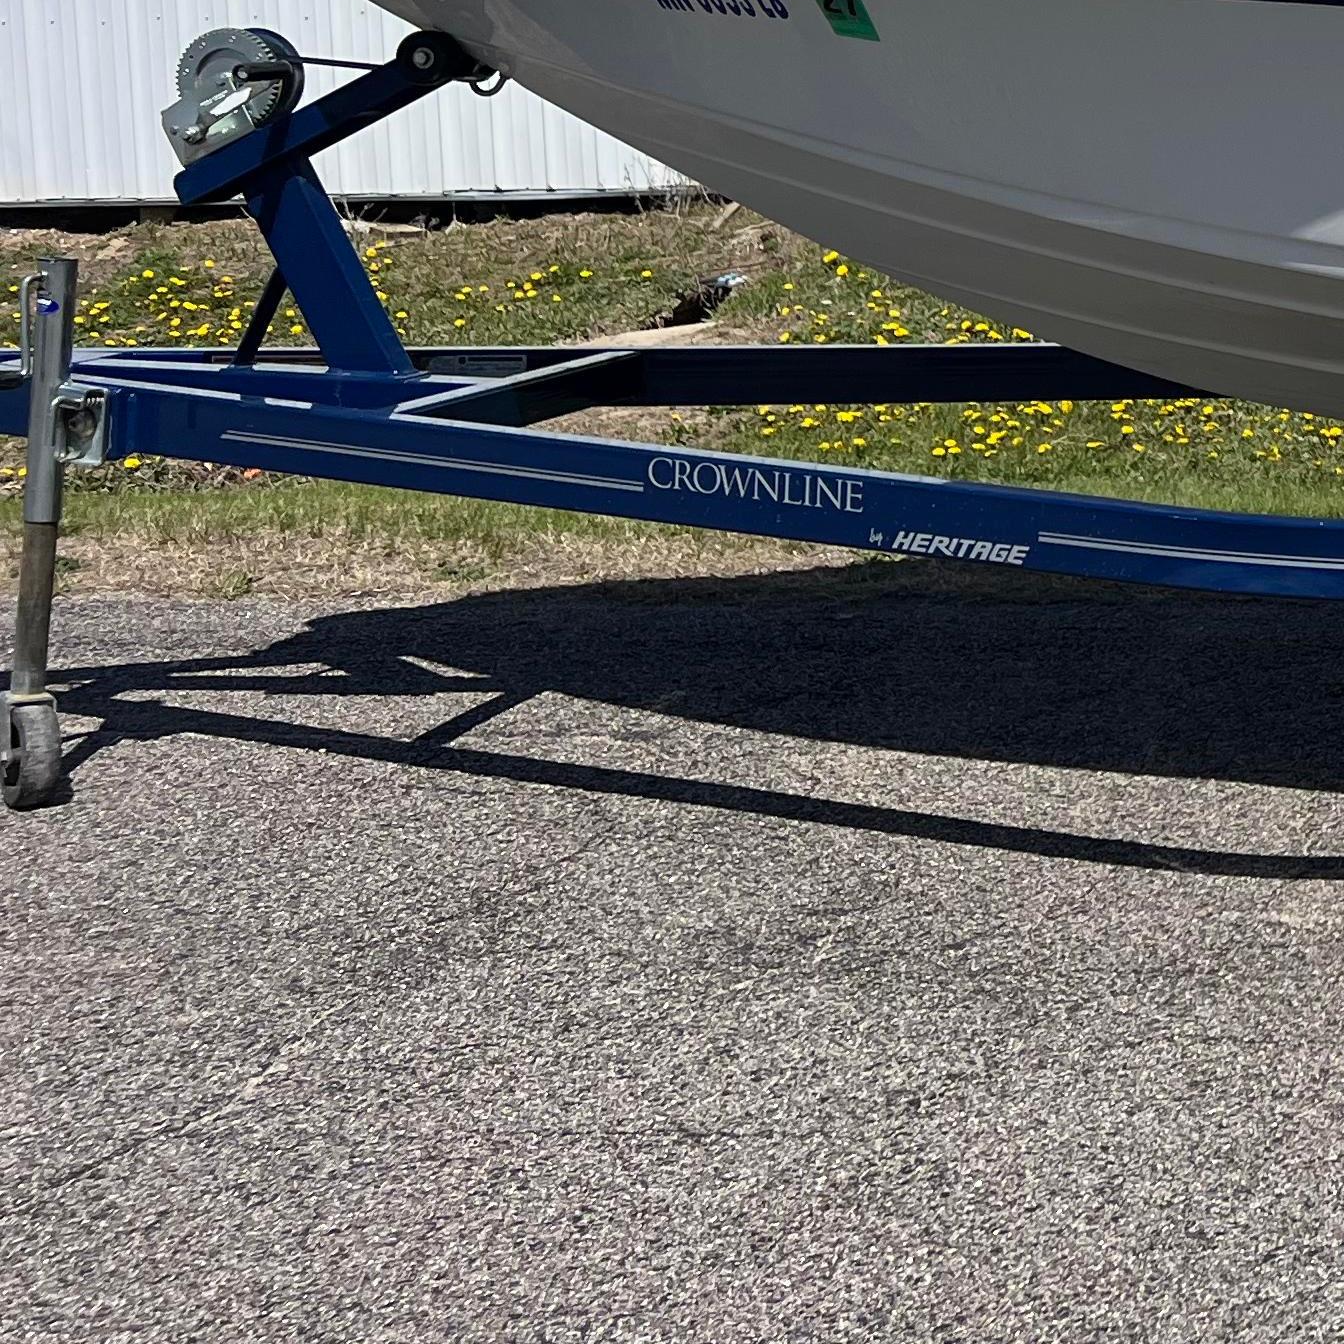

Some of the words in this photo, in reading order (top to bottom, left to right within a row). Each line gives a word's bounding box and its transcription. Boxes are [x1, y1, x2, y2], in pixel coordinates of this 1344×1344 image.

[647, 458, 864, 513] CROWNLINE
[869, 527, 883, 546] by
[891, 530, 1030, 565] HERITAGE
